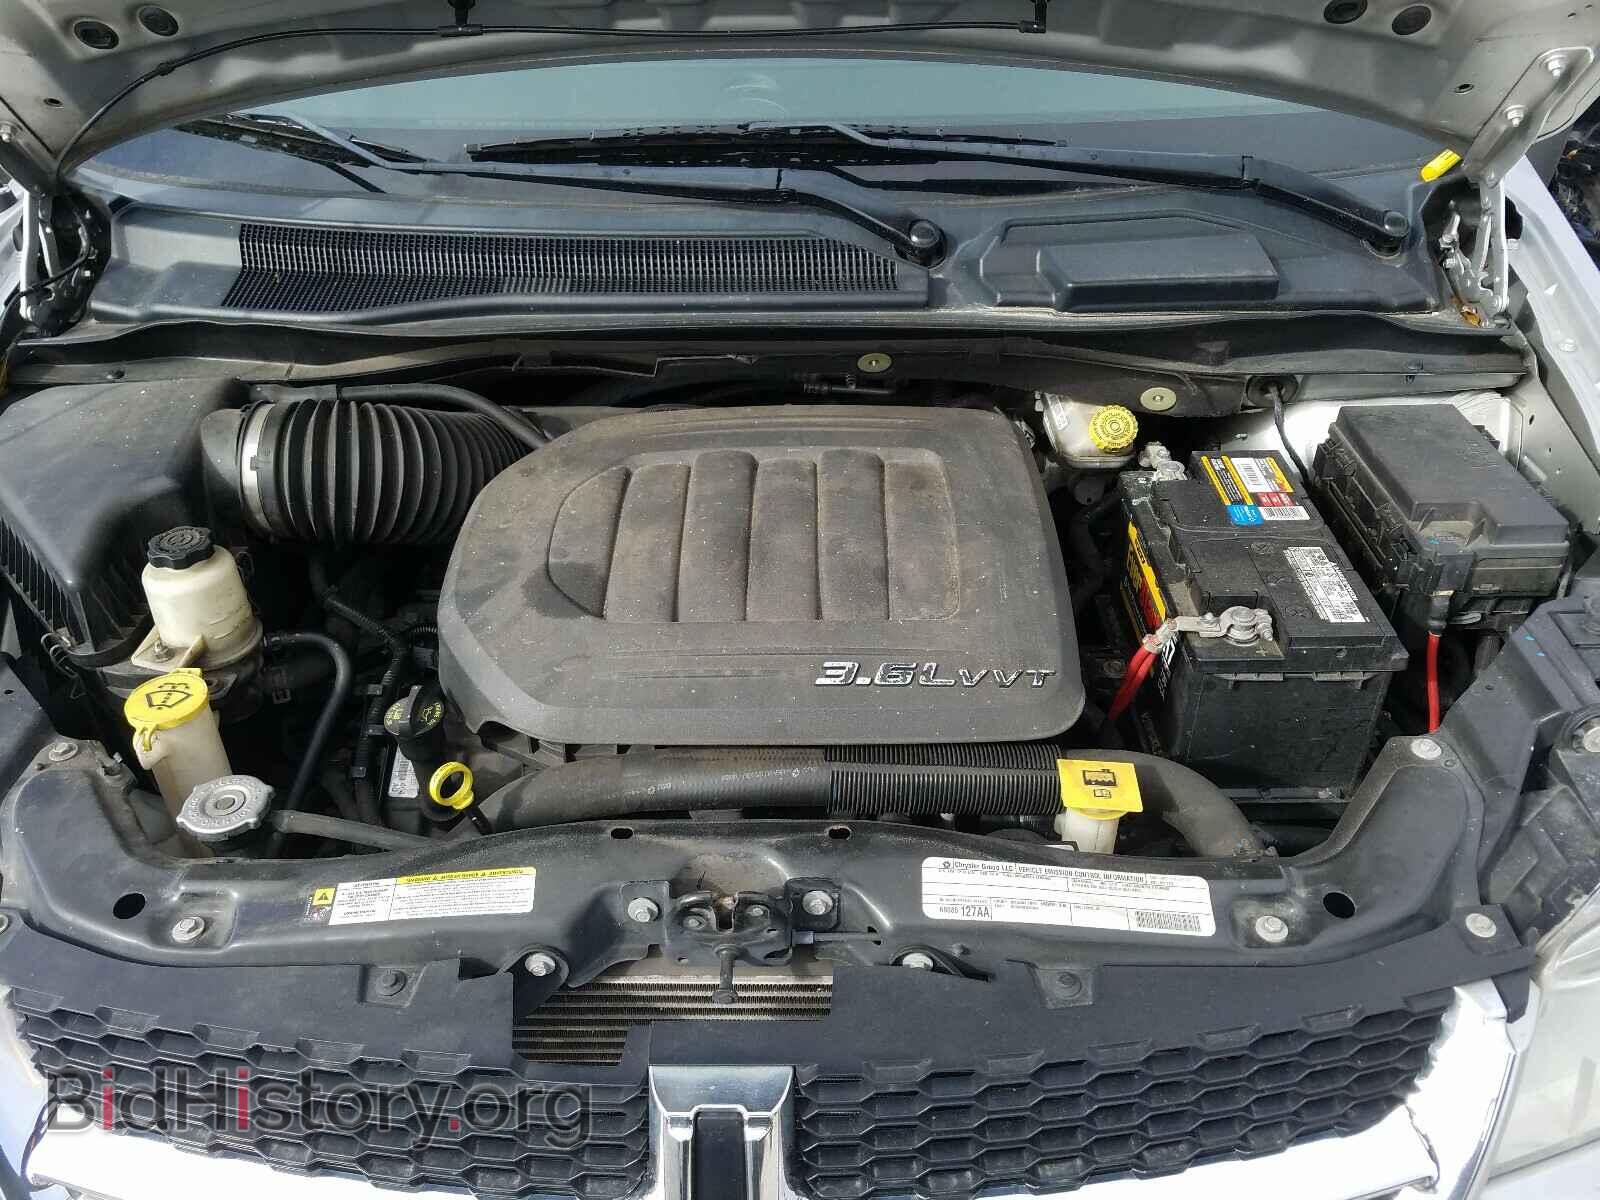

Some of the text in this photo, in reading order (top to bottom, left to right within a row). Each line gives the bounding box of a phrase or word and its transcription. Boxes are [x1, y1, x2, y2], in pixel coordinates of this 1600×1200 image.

[1018, 866, 1043, 875] VEHICLE
[1044, 868, 1073, 877] EMISSION
[960, 904, 991, 918] 127AA
